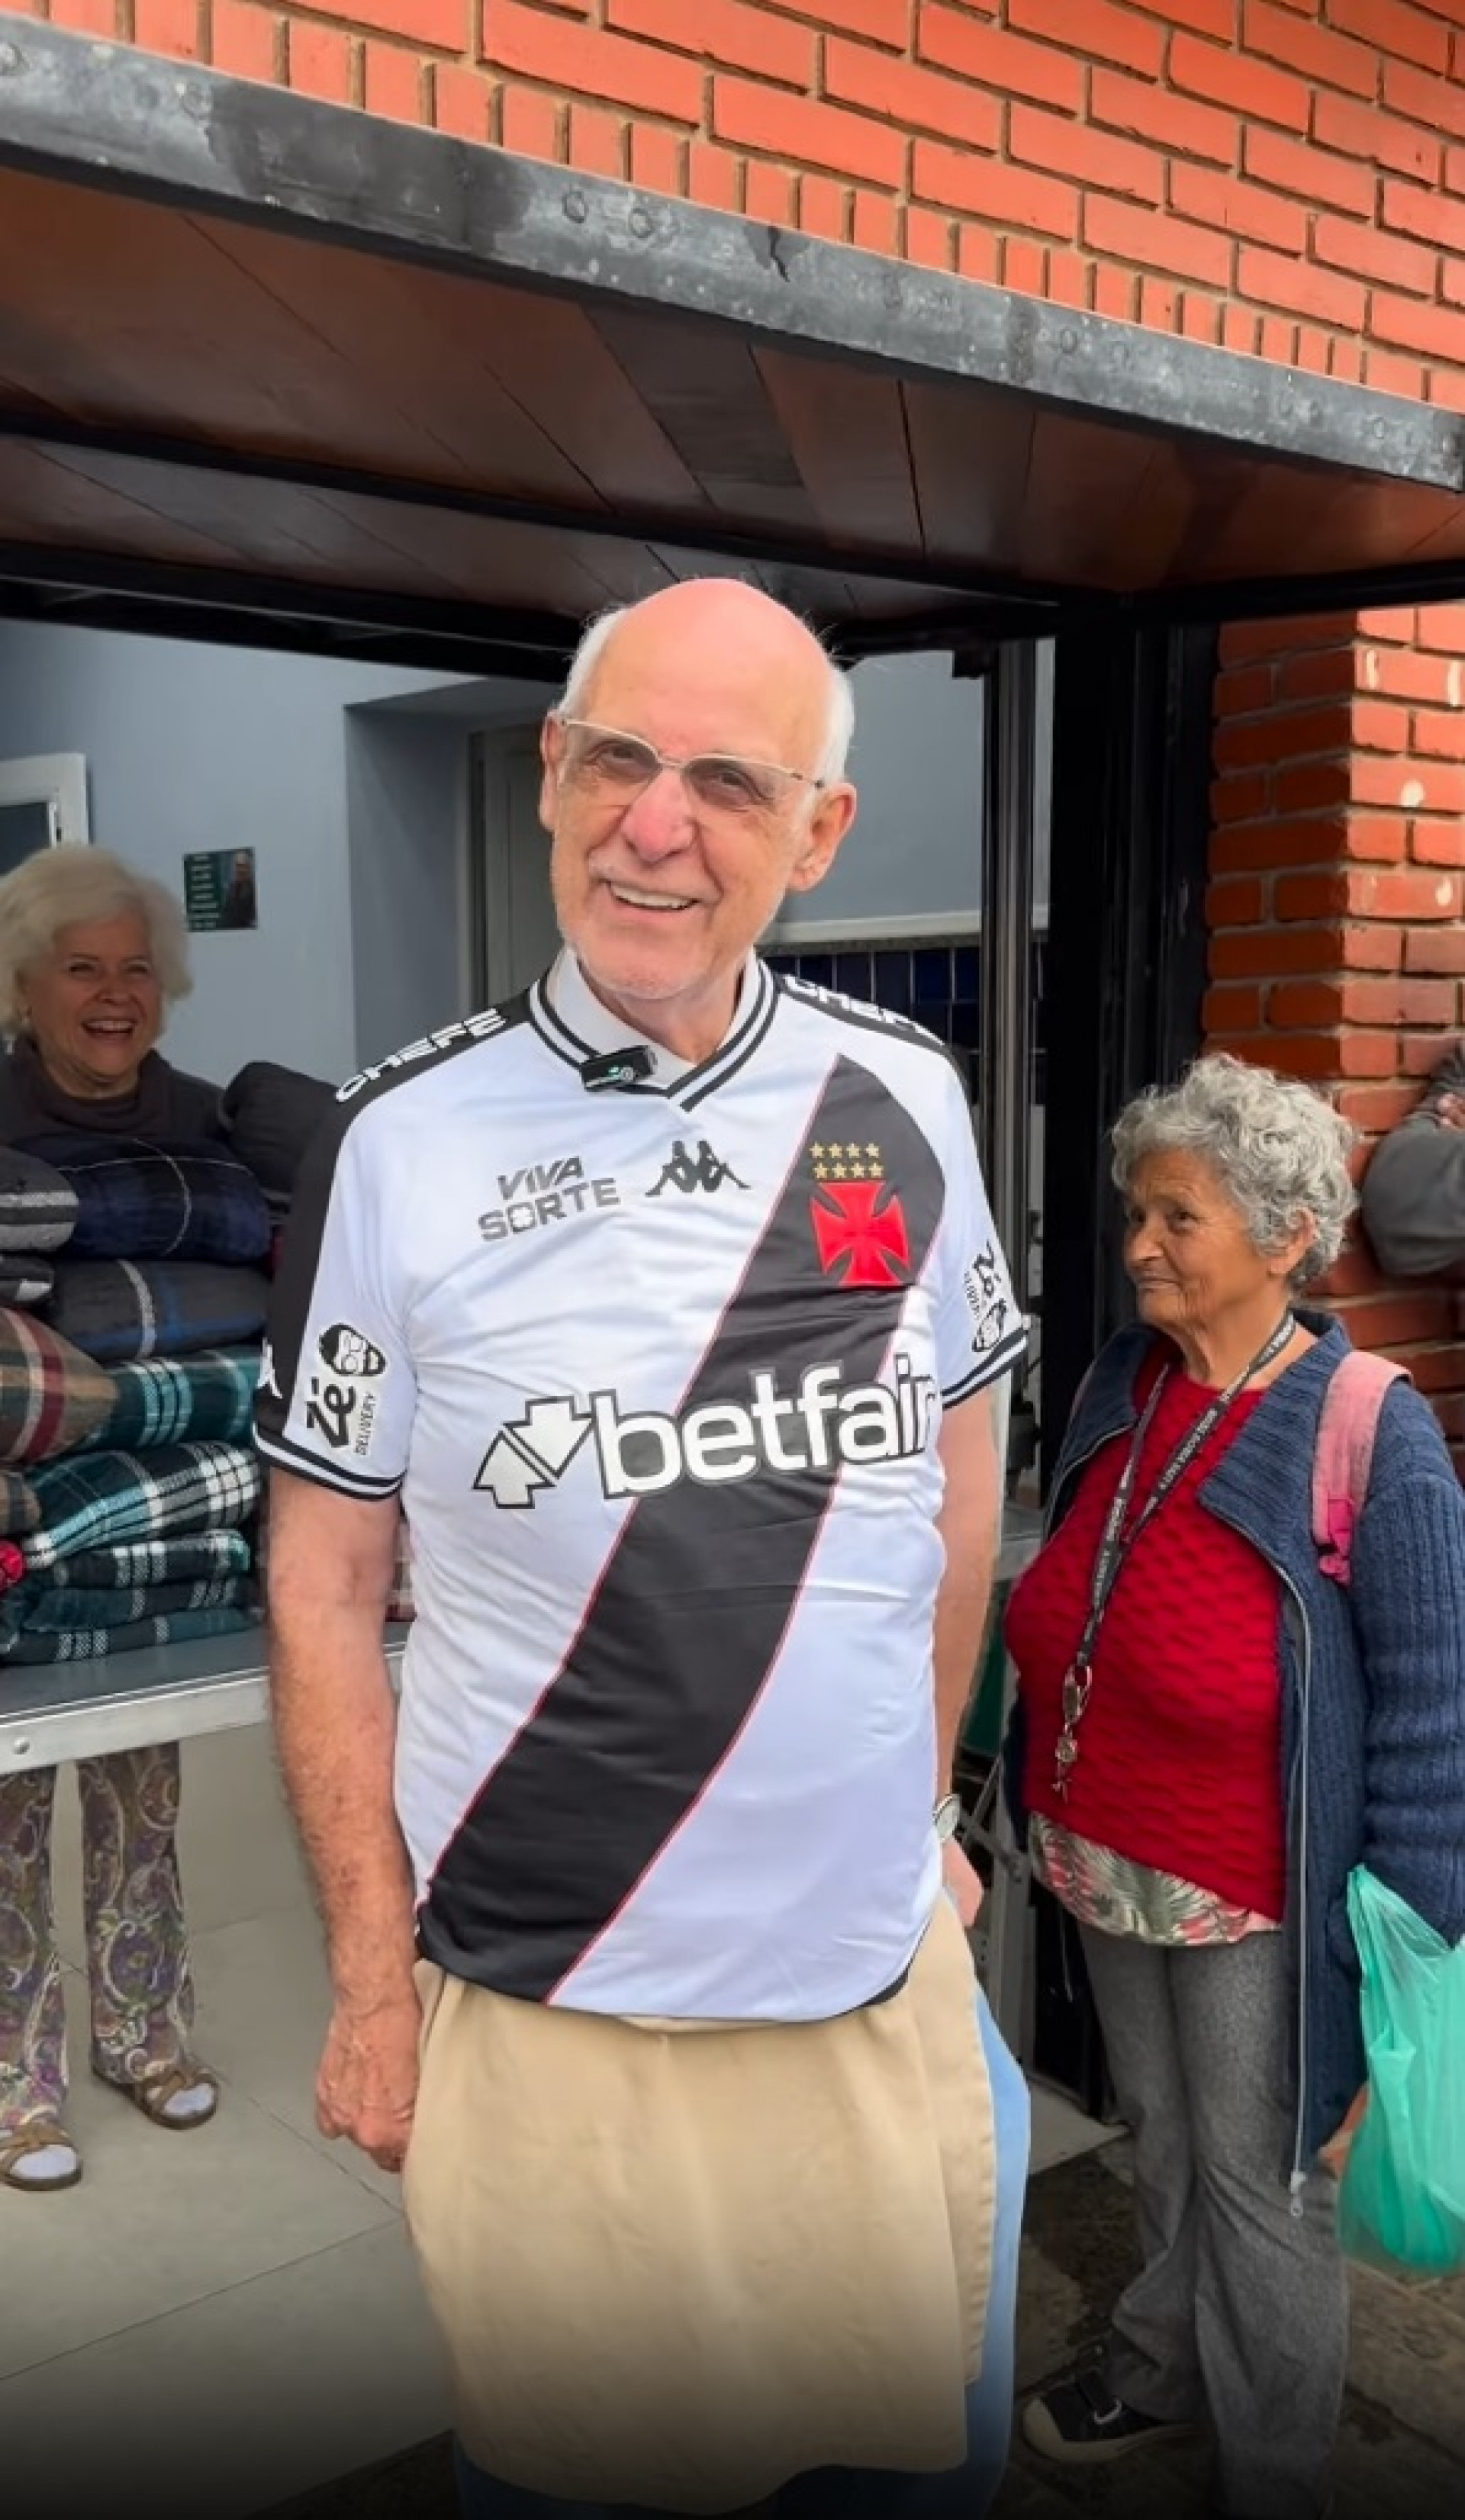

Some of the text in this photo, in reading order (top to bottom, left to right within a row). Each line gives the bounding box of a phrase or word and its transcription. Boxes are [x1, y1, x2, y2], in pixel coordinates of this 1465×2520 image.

[478, 1177, 621, 1242] SORTE
[497, 1155, 584, 1201] VIVA
[588, 1352, 935, 1501] betfair
